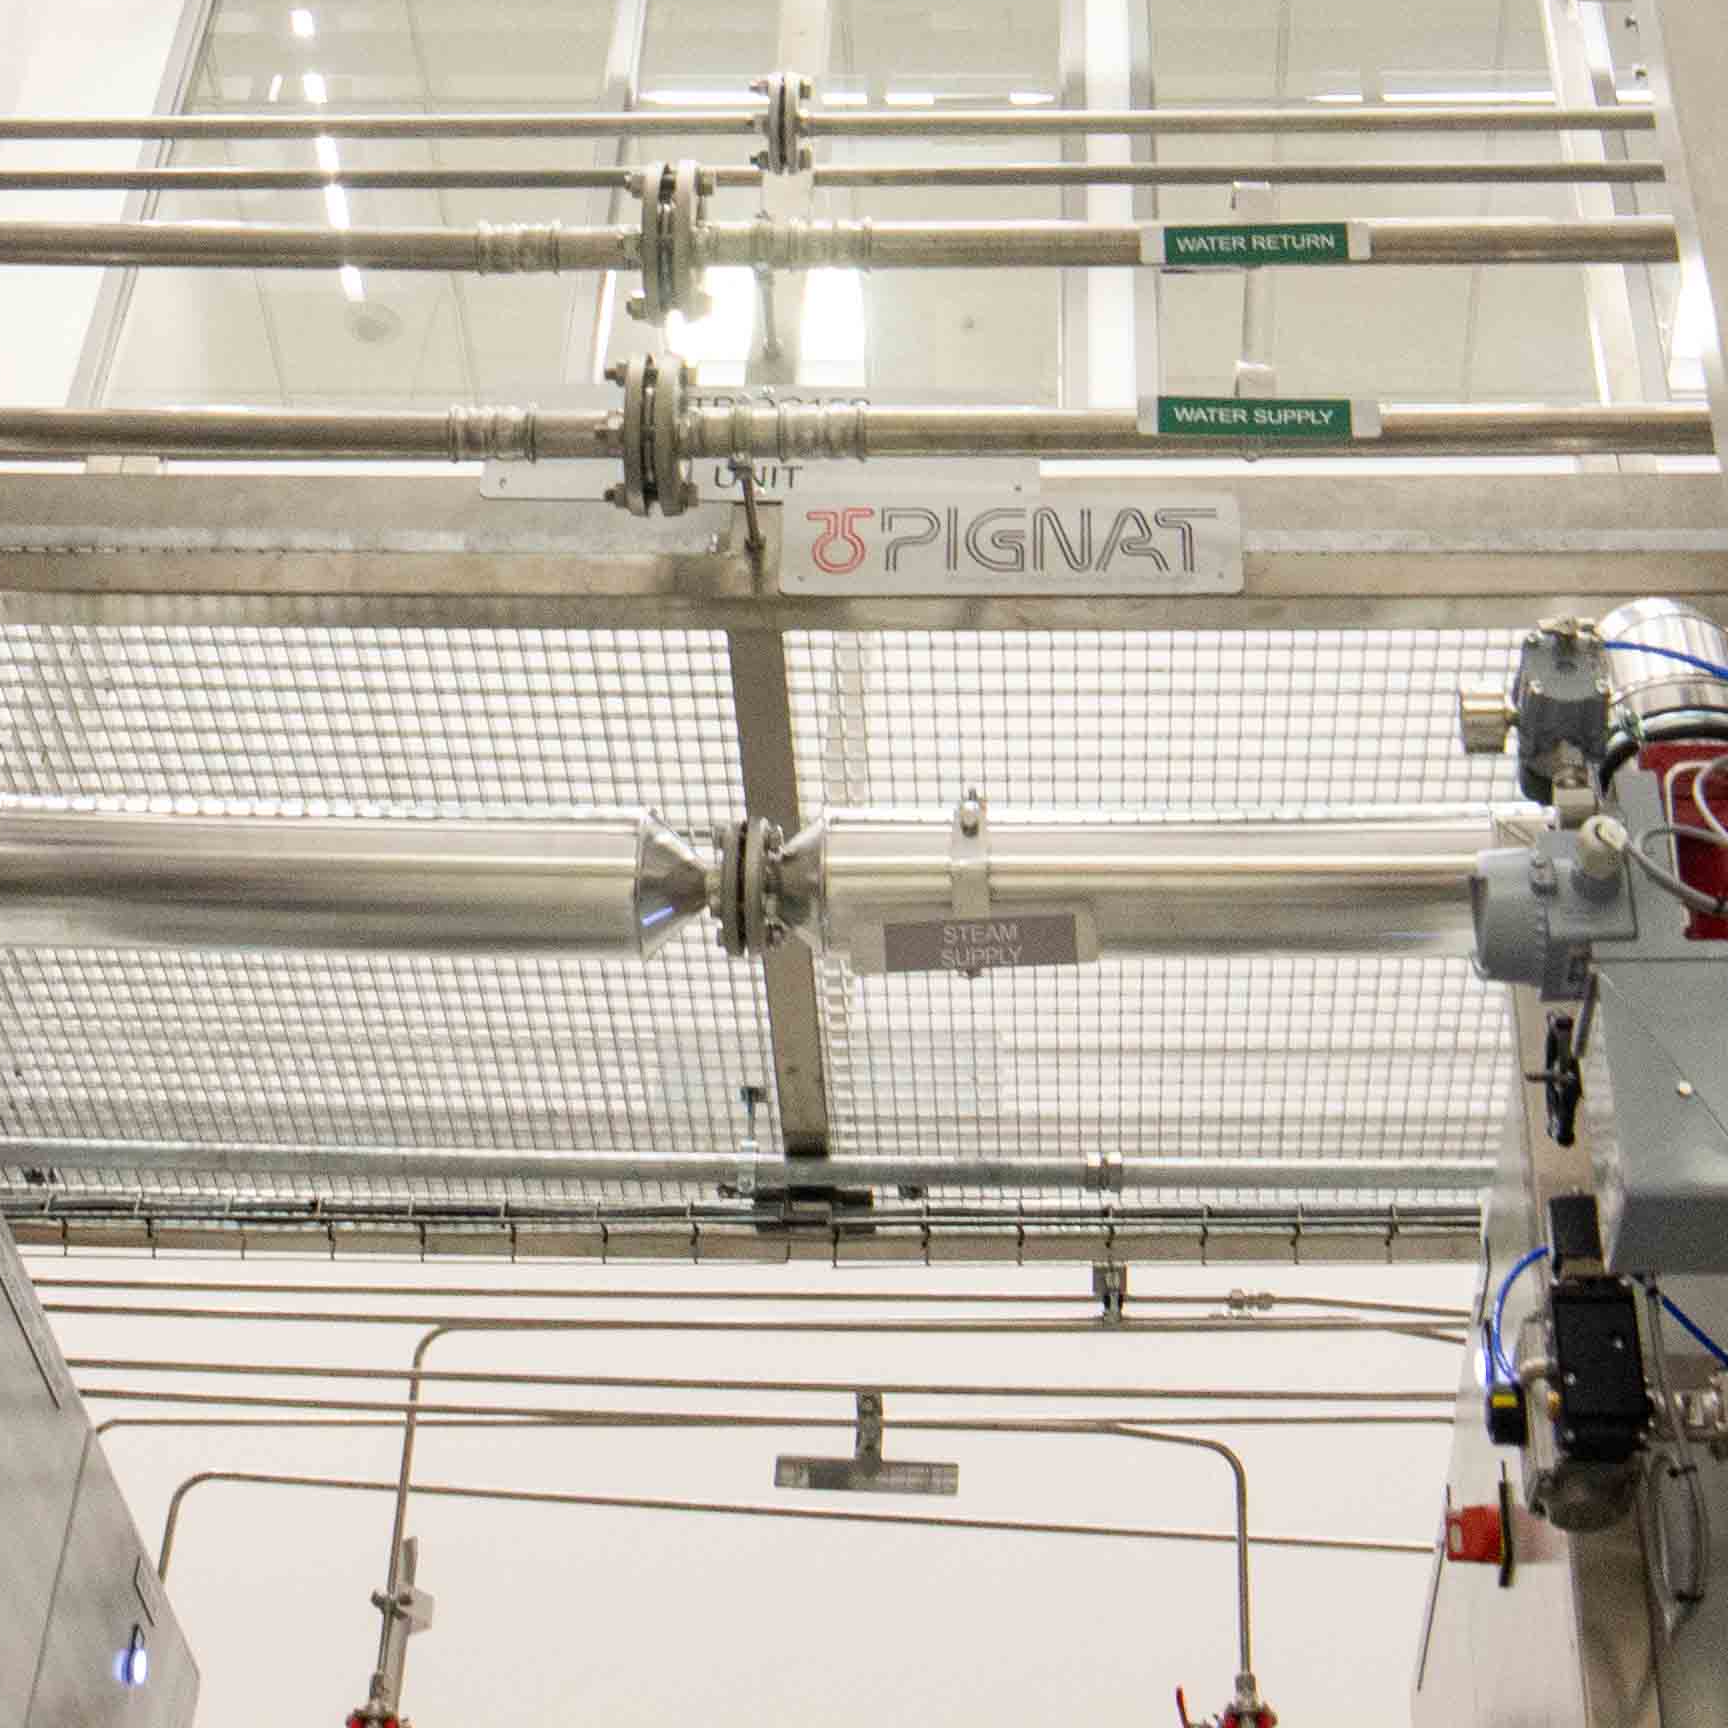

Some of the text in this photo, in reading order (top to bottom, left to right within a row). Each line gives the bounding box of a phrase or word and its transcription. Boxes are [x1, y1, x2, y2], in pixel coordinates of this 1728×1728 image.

[1176, 233, 1335, 253] WATER RETURN
[1174, 406, 1333, 425] WATER SUPPLY
[880, 507, 1217, 572] PIGNAT
[943, 924, 1018, 944] STEAM
[941, 946, 1023, 968] SUPPLY
